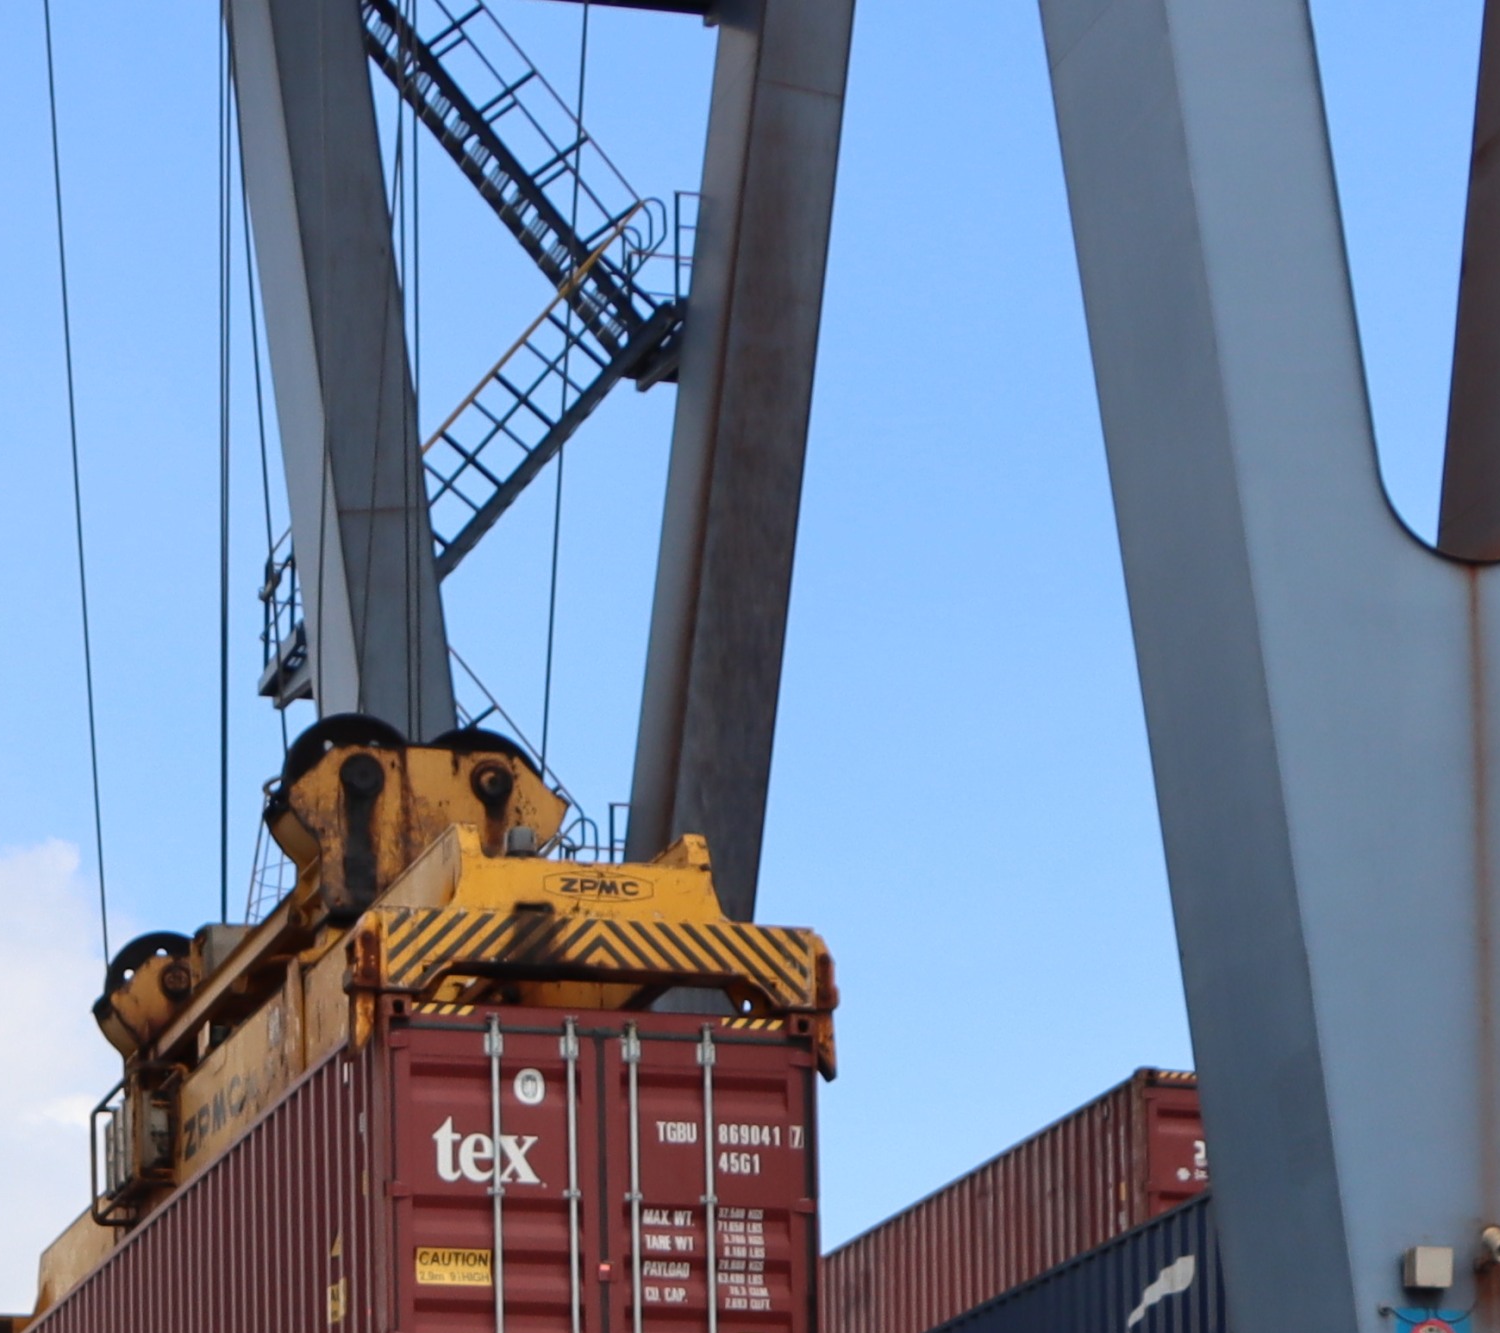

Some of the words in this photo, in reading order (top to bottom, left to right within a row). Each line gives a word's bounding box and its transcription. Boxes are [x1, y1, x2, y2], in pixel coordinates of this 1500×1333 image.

[560, 877, 639, 896] ZPMC
[656, 1121, 697, 1143] TGBU
[718, 1123, 781, 1147] 869041
[791, 1125, 804, 1148] 7
[432, 1115, 541, 1185] tex
[718, 1152, 761, 1175] 45G1
[418, 1251, 489, 1267] CAUTION
